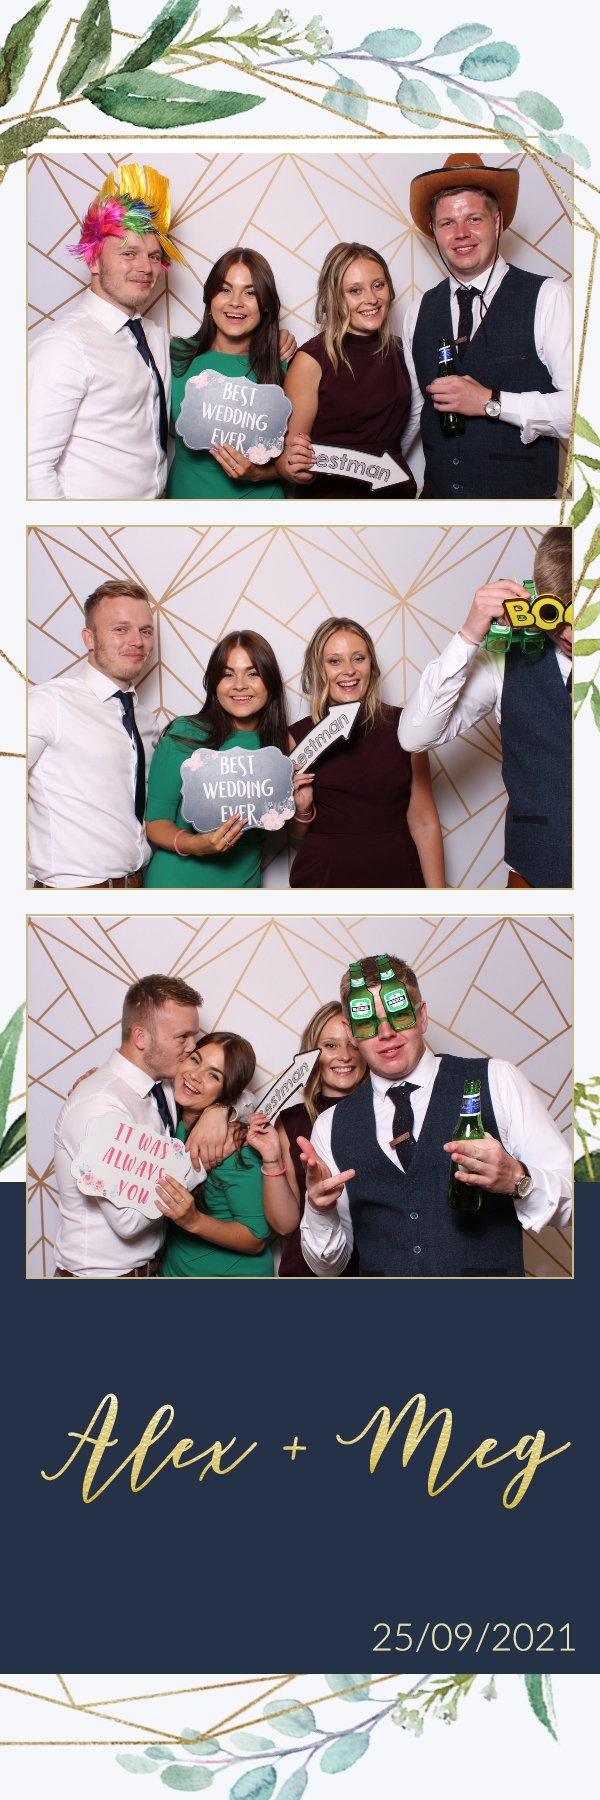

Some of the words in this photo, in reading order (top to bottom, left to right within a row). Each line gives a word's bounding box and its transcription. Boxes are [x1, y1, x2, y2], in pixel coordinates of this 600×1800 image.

[222, 382, 258, 407] BEST
[202, 402, 268, 431] WEDDING
[210, 428, 248, 456] EVER
[311, 449, 392, 482] estman
[502, 594, 572, 632] BO
[291, 713, 350, 766] estman
[220, 755, 255, 777] BEST
[202, 779, 274, 800] WEDDING
[221, 803, 258, 826] EVER
[260, 1062, 309, 1115] estman
[114, 1122, 136, 1144] IT
[138, 1133, 169, 1159] WAS
[102, 1147, 165, 1185] ALWAYS
[118, 1179, 149, 1204] YOU
